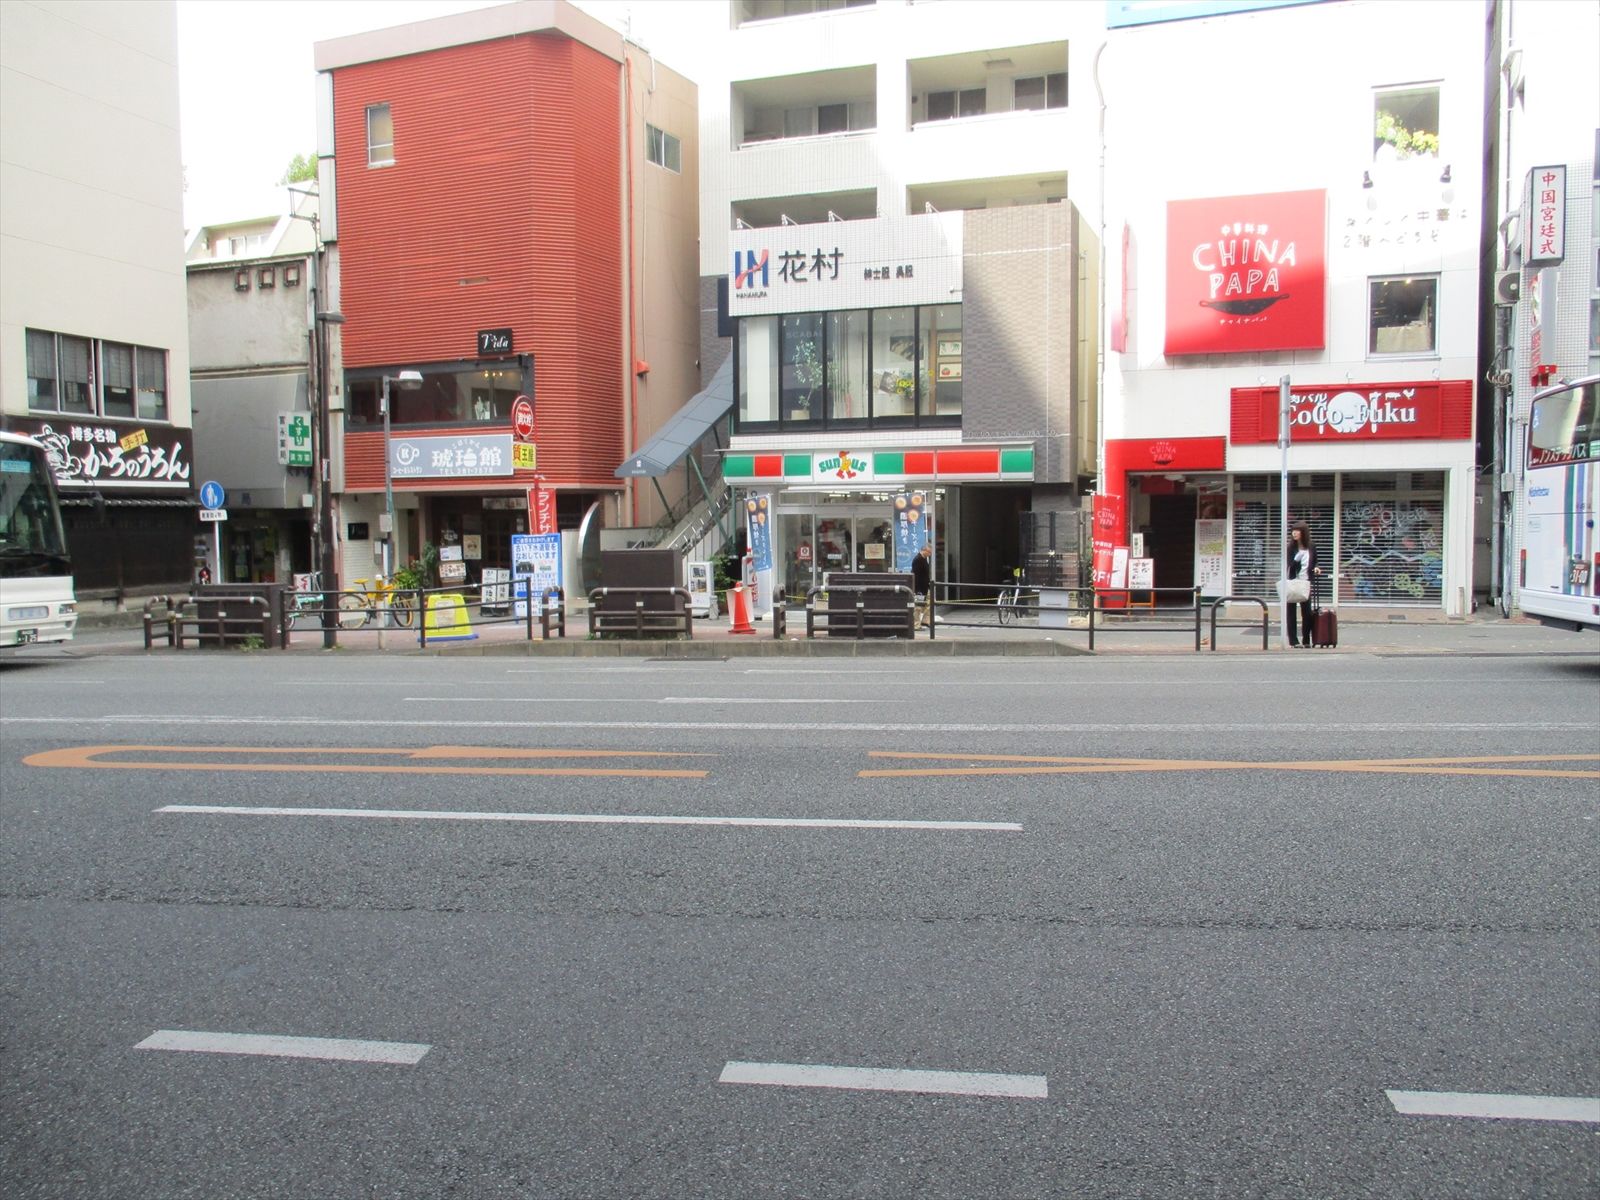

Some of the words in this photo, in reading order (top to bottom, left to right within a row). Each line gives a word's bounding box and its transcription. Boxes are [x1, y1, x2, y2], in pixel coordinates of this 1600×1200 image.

[1540, 172, 1556, 255] 中国宮廷式
[778, 247, 844, 283] 花村
[1193, 238, 1296, 271] CHINA
[864, 266, 890, 280] 紳士服
[1209, 268, 1279, 299] PAPA
[71, 426, 117, 443] 博多名物
[81, 442, 190, 481] かろのうろん
